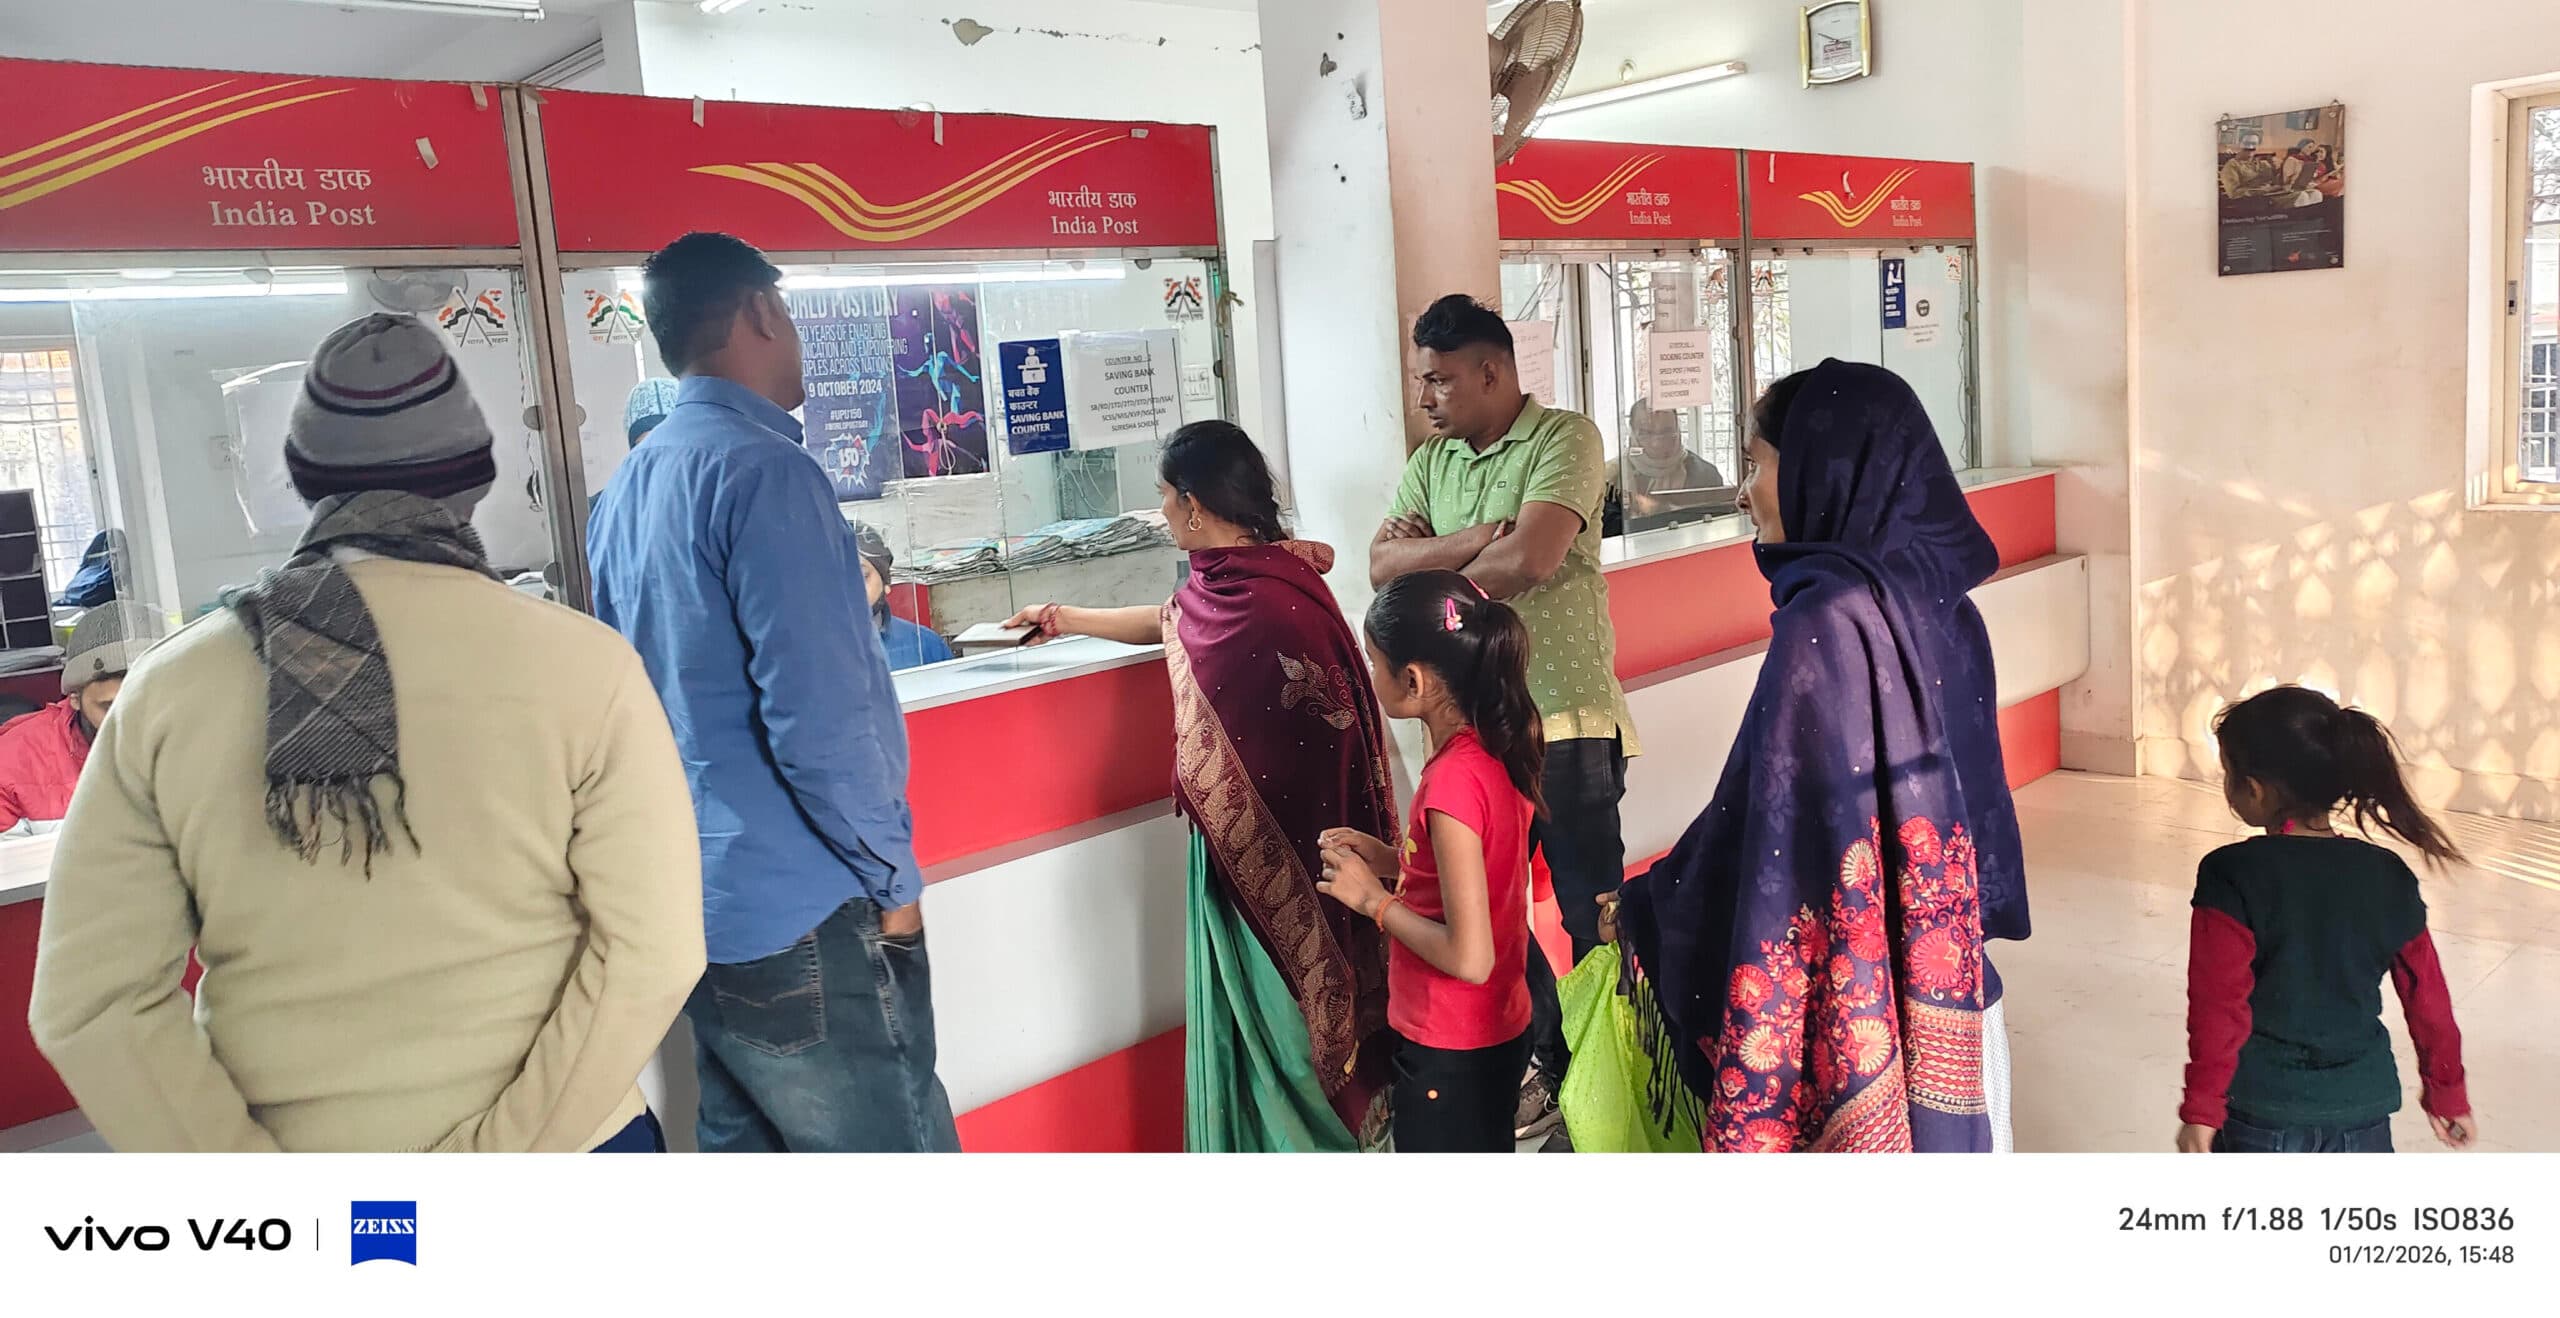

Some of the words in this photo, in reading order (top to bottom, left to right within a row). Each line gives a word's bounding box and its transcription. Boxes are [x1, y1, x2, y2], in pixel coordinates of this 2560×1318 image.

[202, 158, 307, 190] भारतीय
[314, 168, 372, 191] डाक
[1048, 185, 1103, 208] भारतीय
[1107, 192, 1137, 208] डाक
[208, 200, 298, 226] India
[306, 201, 377, 226] Post
[1629, 210, 1653, 225] India
[1652, 210, 1672, 225] Post
[1051, 215, 1097, 234] India
[1102, 216, 1139, 234] Post
[831, 290, 870, 318] POST
[810, 324, 836, 341] YEARS
[838, 324, 848, 340] OF
[849, 322, 887, 340] ENABLING
[841, 341, 857, 358] AND
[830, 358, 859, 376] ACROSS
[1104, 370, 1133, 381] SAVING
[1134, 368, 1156, 378] BANK
[808, 382, 816, 397] 9
[817, 380, 858, 397] OCTOBER
[859, 379, 882, 395] 2024
[1114, 384, 1149, 395] COUNTER
[830, 408, 862, 421] #UPU150
[1010, 413, 1041, 424] SAVING
[1042, 410, 1065, 420] BANK
[1011, 423, 1051, 434] COUNTER
